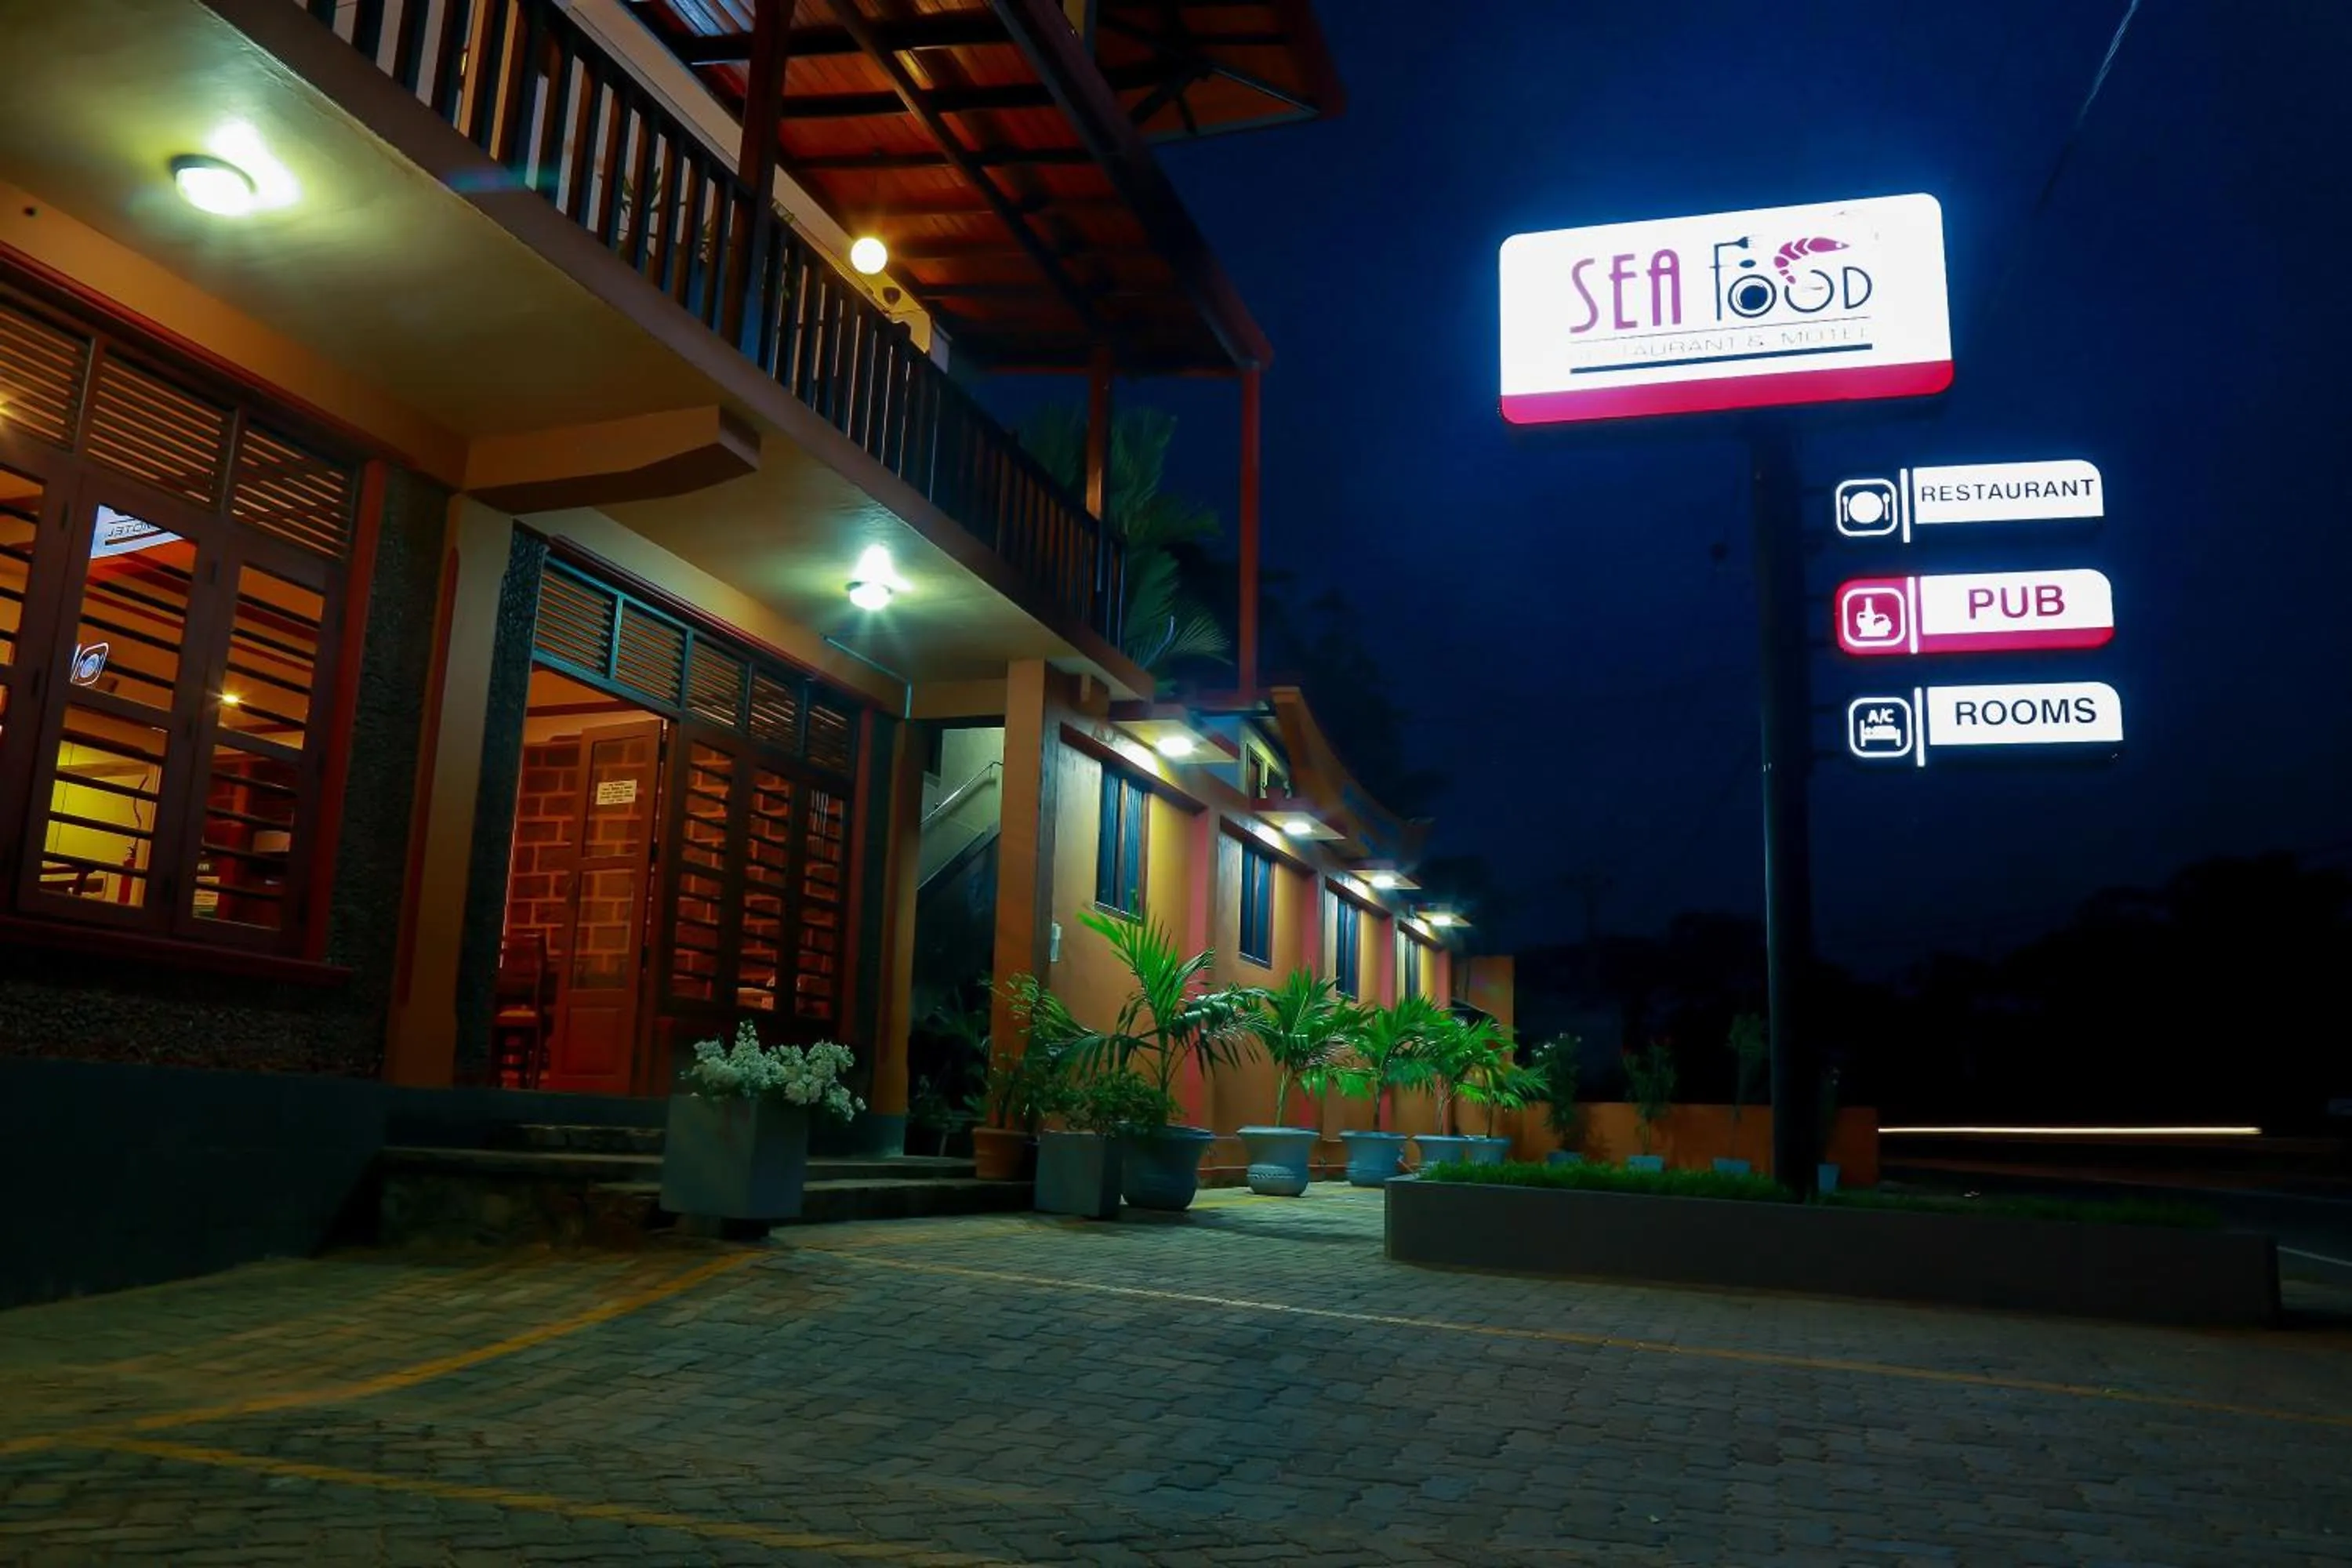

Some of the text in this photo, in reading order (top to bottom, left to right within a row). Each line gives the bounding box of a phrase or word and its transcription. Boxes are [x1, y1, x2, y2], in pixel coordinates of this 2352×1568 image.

[1570, 235, 1873, 333] SEA FOOD
[1748, 335, 1764, 348] &
[1921, 479, 2095, 502] RESTAURANT
[1968, 585, 2065, 619] PUB
[1867, 708, 1894, 724] A/C
[1955, 698, 2097, 726] ROOMS
